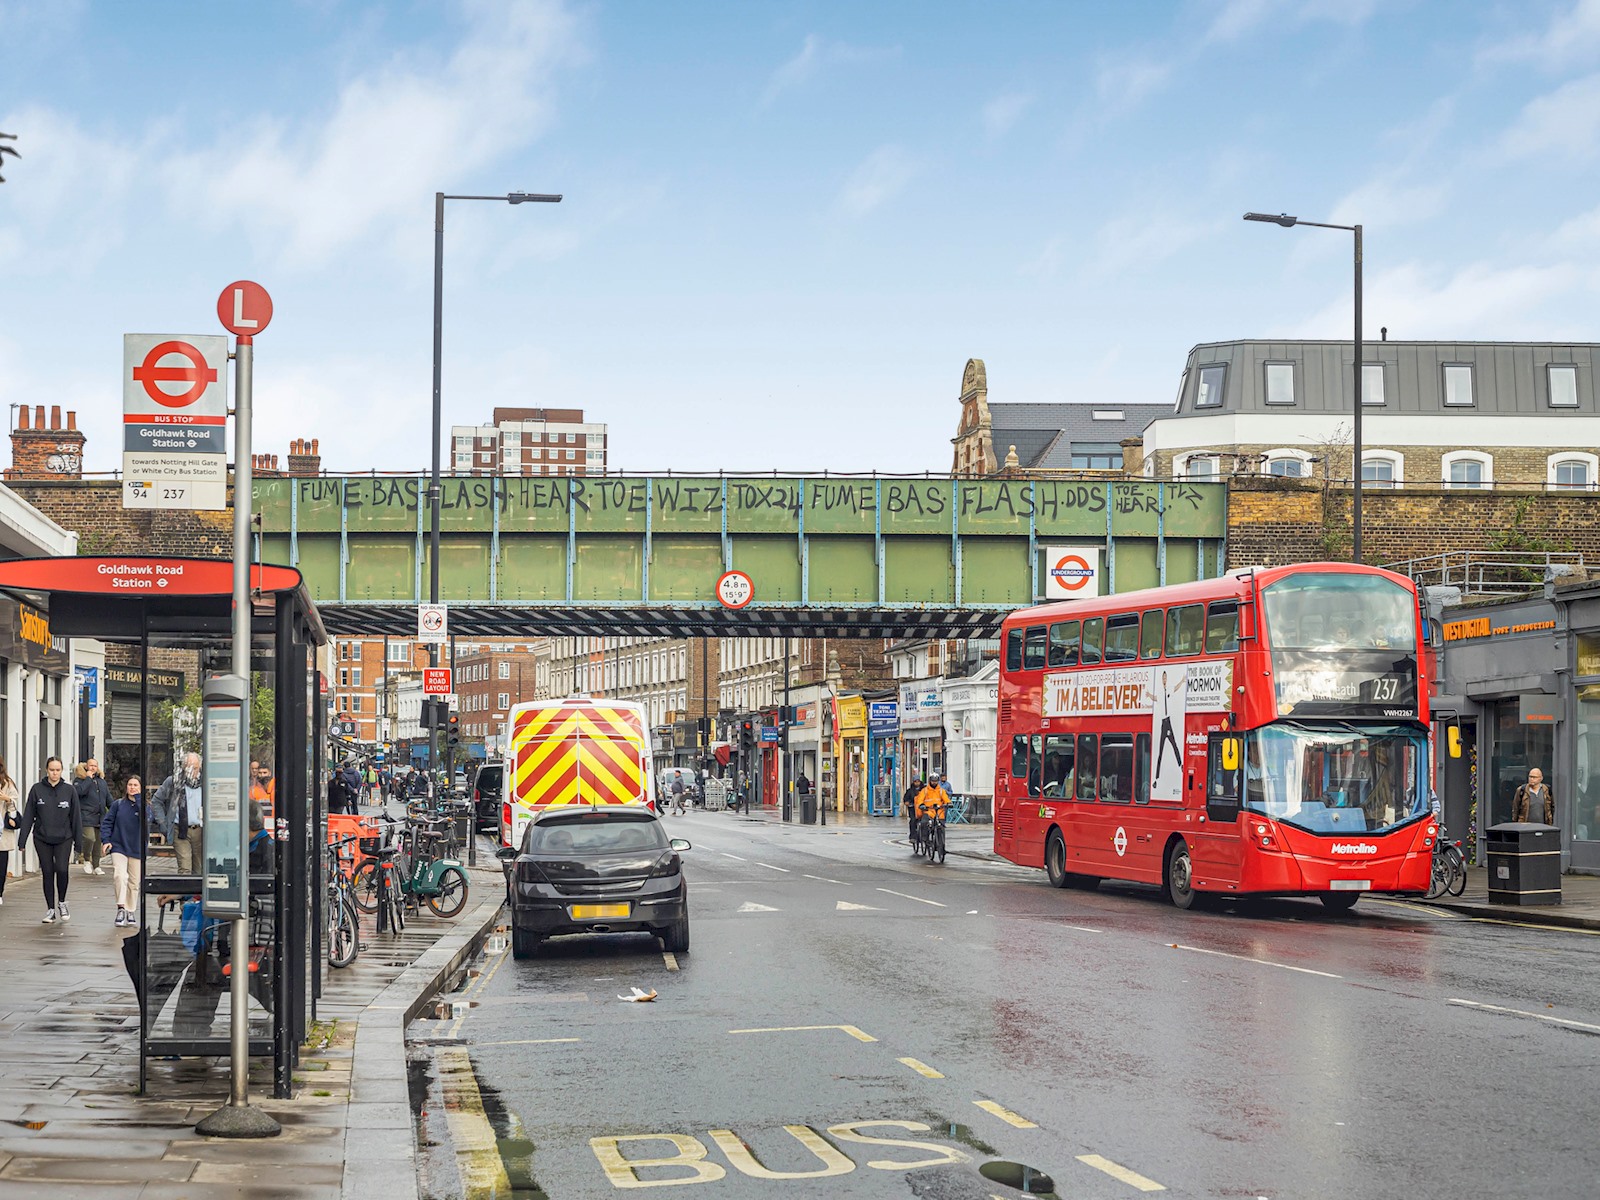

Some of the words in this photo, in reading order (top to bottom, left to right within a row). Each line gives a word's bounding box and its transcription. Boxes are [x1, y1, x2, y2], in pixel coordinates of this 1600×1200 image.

[234, 288, 258, 328] L
[154, 415, 170, 423] BUS
[173, 416, 194, 424] STOP
[140, 429, 185, 438] Goldhawk
[187, 430, 210, 438] Road
[152, 439, 185, 447] Station
[133, 489, 147, 498] 94
[163, 489, 184, 499] 237
[300, 481, 365, 508] FUME
[372, 479, 419, 511] BAS
[520, 478, 591, 514] HEAR
[594, 480, 648, 512] TOE
[658, 480, 724, 513] WIZ
[811, 484, 877, 515] FUME
[886, 484, 946, 515] BAS
[97, 564, 153, 575] Goldhawk
[155, 565, 183, 575] Road
[112, 577, 152, 588] Station
[723, 580, 739, 588] 4.8
[20, 603, 52, 655] Sainsburys
[1199, 666, 1213, 676] BOOK
[1214, 665, 1222, 675] OF
[108, 670, 125, 681] THE
[158, 675, 179, 686] NEST
[1187, 677, 1221, 692] MORMON
[1373, 678, 1399, 700] 237
[1071, 687, 1079, 711] A
[1383, 709, 1413, 717] VWH2267
[1331, 842, 1378, 855] Metroline
[589, 1120, 972, 1188] BUS
